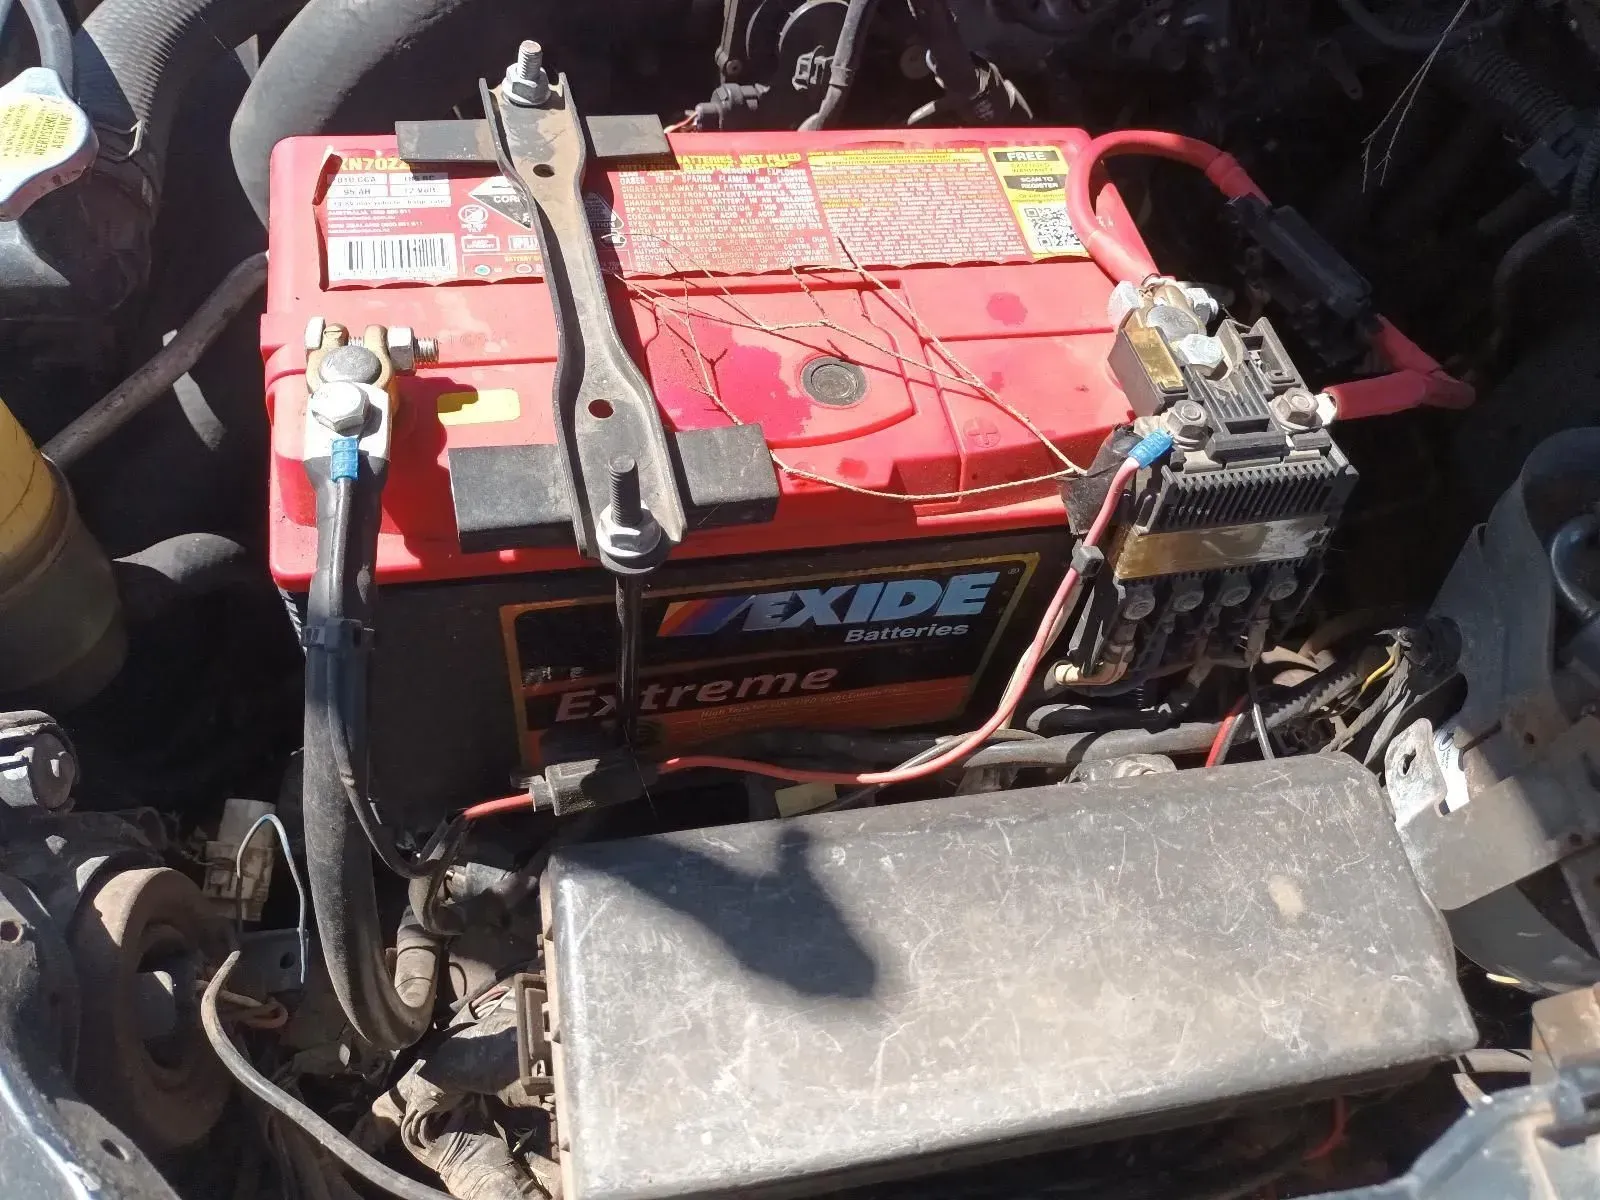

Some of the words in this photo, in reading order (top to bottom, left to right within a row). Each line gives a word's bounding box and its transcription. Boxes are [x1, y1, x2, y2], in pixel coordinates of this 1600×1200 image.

[1007, 151, 1047, 162] FREE
[755, 175, 770, 184] AND
[672, 183, 695, 192] AWAY
[698, 183, 721, 192] FROM
[622, 192, 657, 200] OBJECTS
[659, 191, 681, 200] AWAY
[683, 191, 706, 199] FROM
[624, 199, 665, 207] CHARGING
[669, 198, 681, 206] OR
[684, 198, 708, 206] USING
[712, 197, 746, 206] BATTERY
[661, 205, 694, 213] PROVIDE
[671, 211, 716, 219] SULPHURIC
[679, 219, 691, 227] OR
[682, 226, 716, 234] AMOUNT
[718, 225, 729, 233] OF
[694, 232, 736, 240] PHYSICIAN
[812, 236, 828, 244] OUR
[690, 246, 722, 254] BATTERY
[693, 253, 708, 261] NOT
[758, 249, 802, 258] HOUSEHOLD
[743, 571, 1001, 632] EXIDE
[844, 622, 970, 643] Batteries
[555, 667, 840, 722] Extreme
